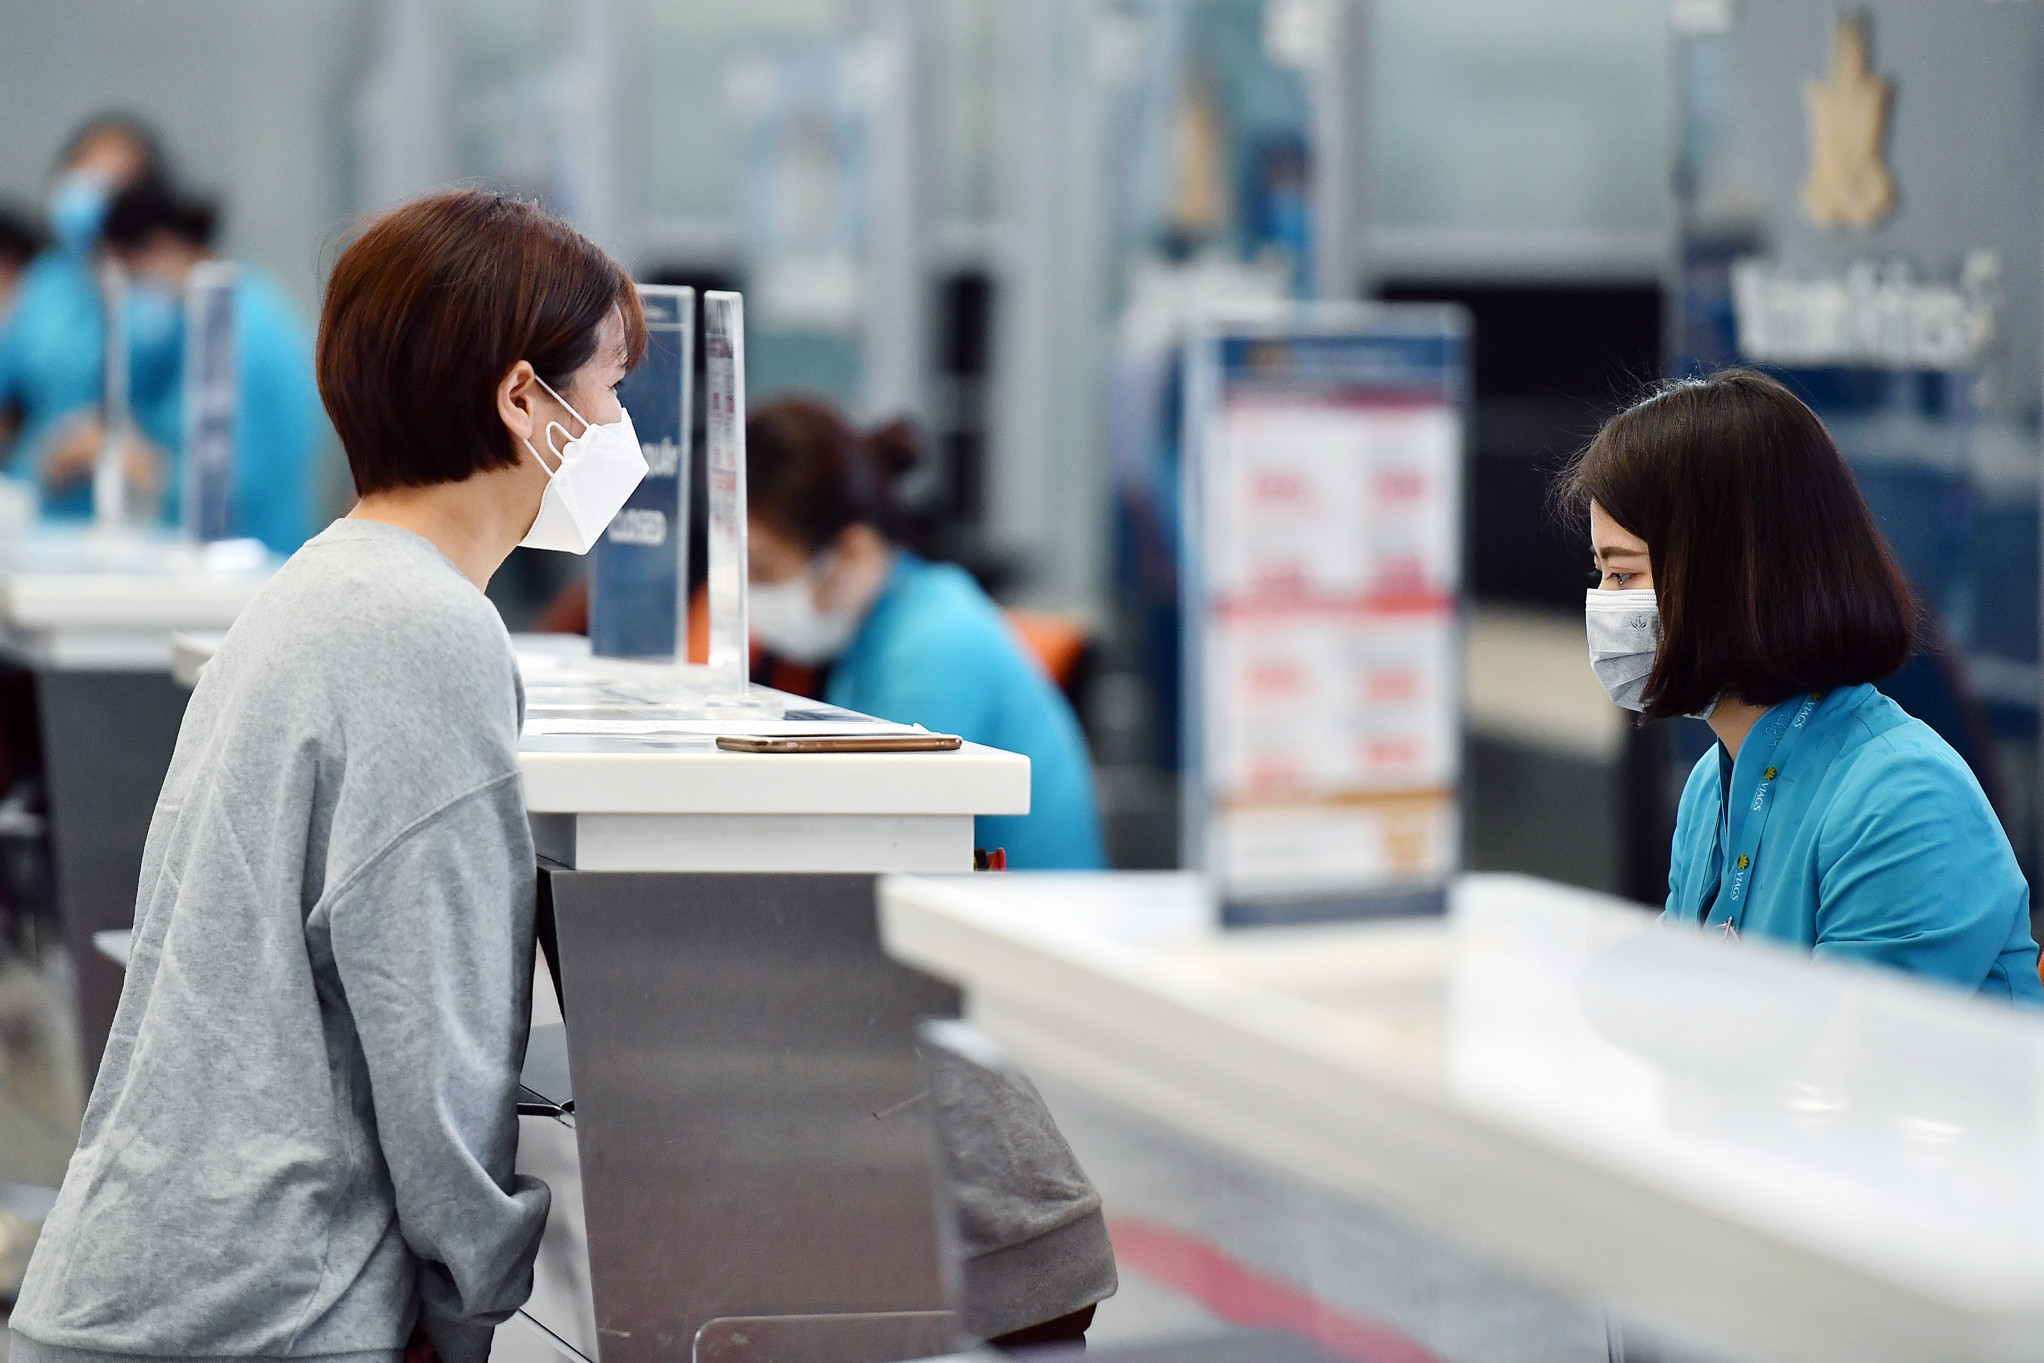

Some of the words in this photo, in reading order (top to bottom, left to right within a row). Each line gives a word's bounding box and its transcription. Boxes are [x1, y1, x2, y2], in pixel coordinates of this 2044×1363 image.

[1794, 702, 1816, 729] VIAGS
[1753, 783, 1769, 811] VIAGS
[1732, 872, 1745, 902] VIAGS
